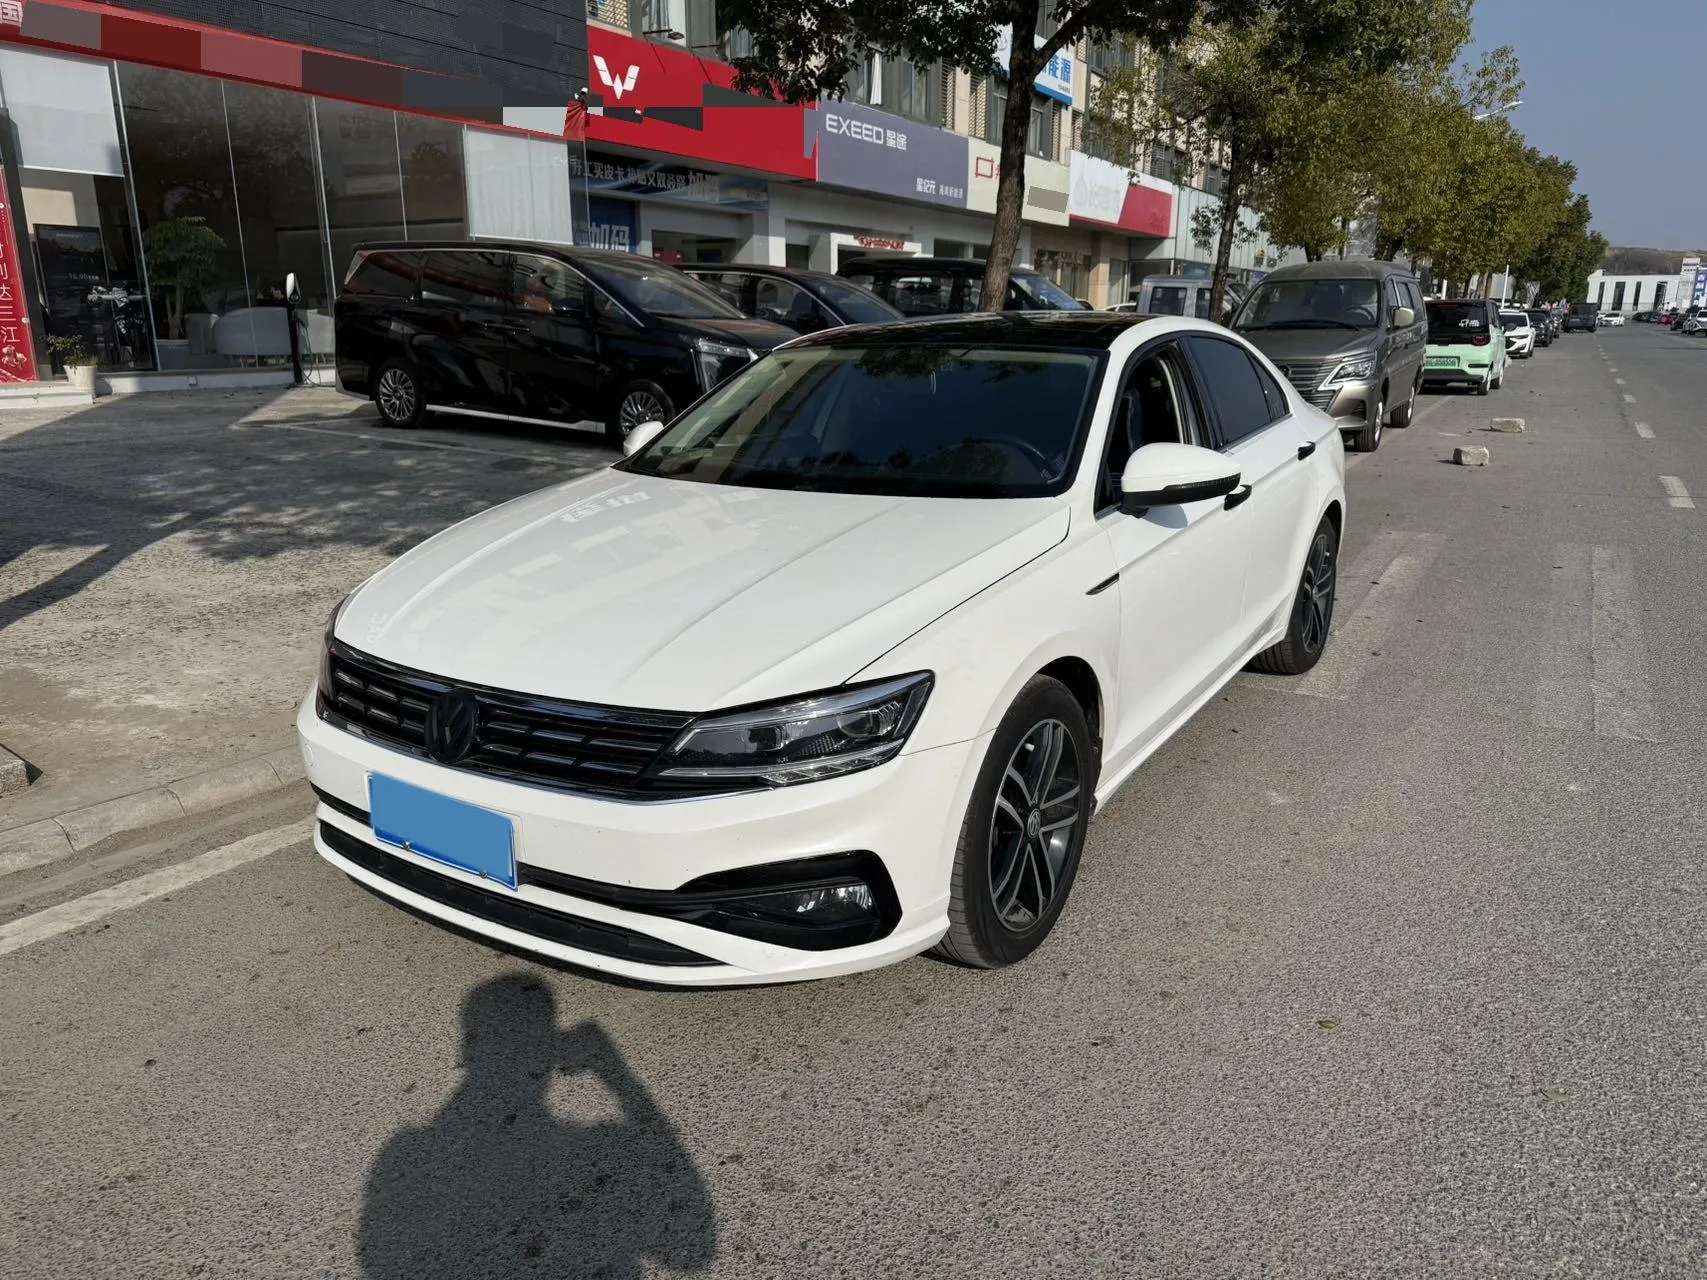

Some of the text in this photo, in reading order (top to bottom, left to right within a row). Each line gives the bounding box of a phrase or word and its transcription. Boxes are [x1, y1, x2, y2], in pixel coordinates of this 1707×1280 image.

[1, 1, 20, 23] 国
[825, 113, 907, 151] EXEED 星途
